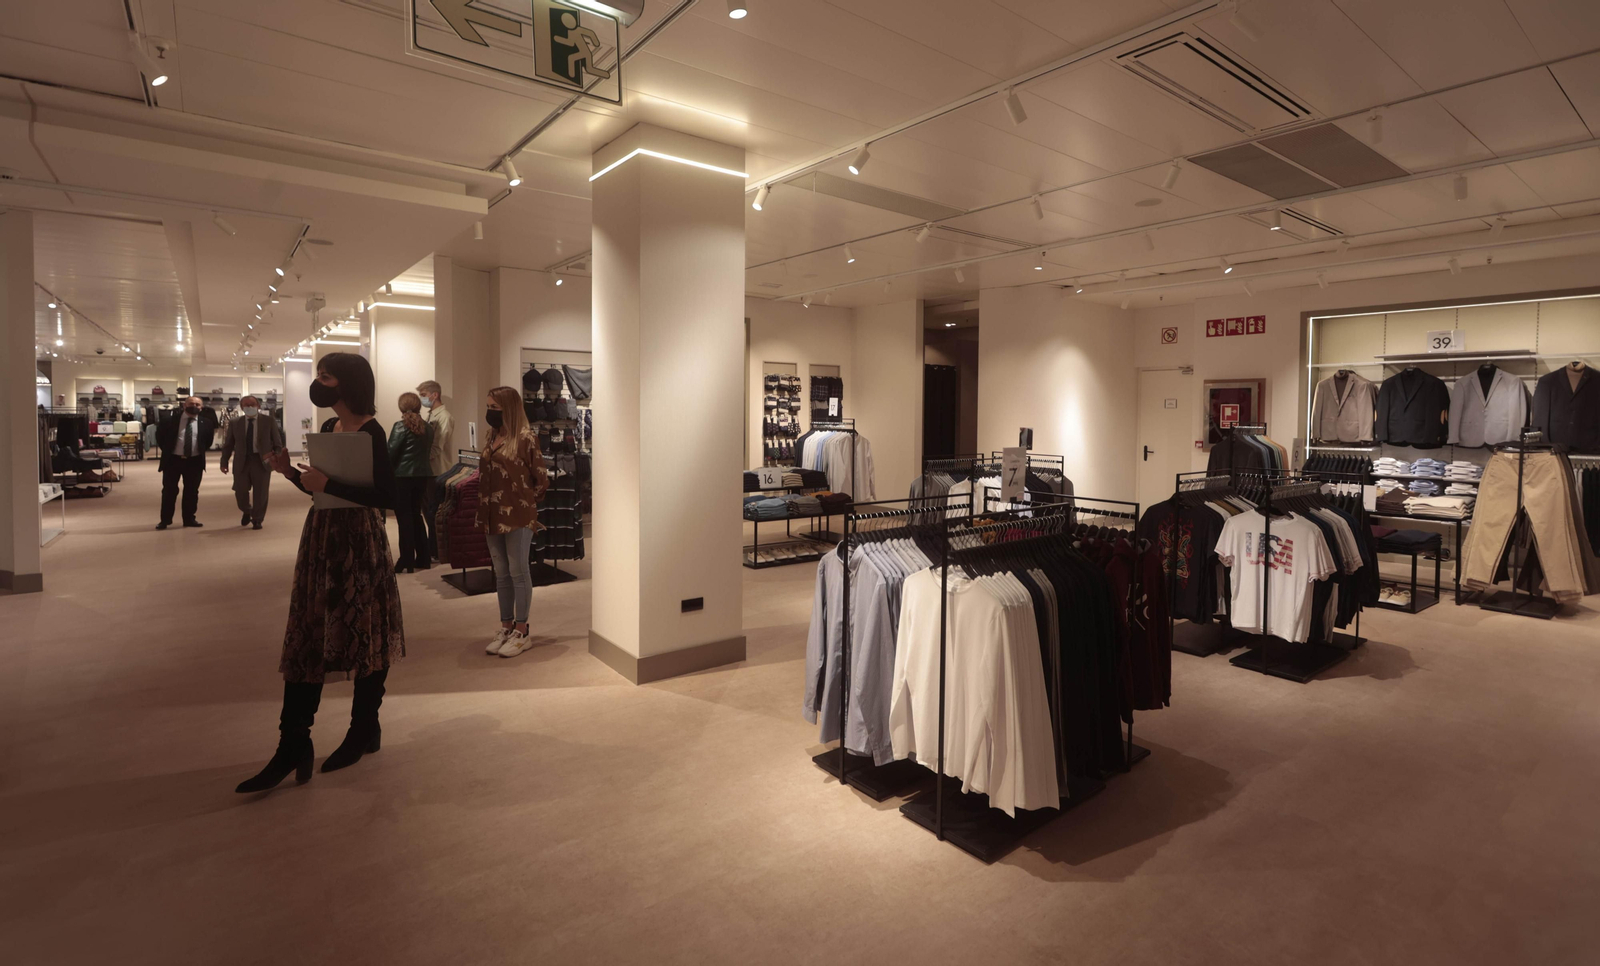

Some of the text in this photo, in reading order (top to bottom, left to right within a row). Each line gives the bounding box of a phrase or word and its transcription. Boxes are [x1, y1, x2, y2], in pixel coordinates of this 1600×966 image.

[1432, 337, 1452, 349] 39
[763, 474, 773, 484] 16
[1245, 532, 1293, 575] USA
